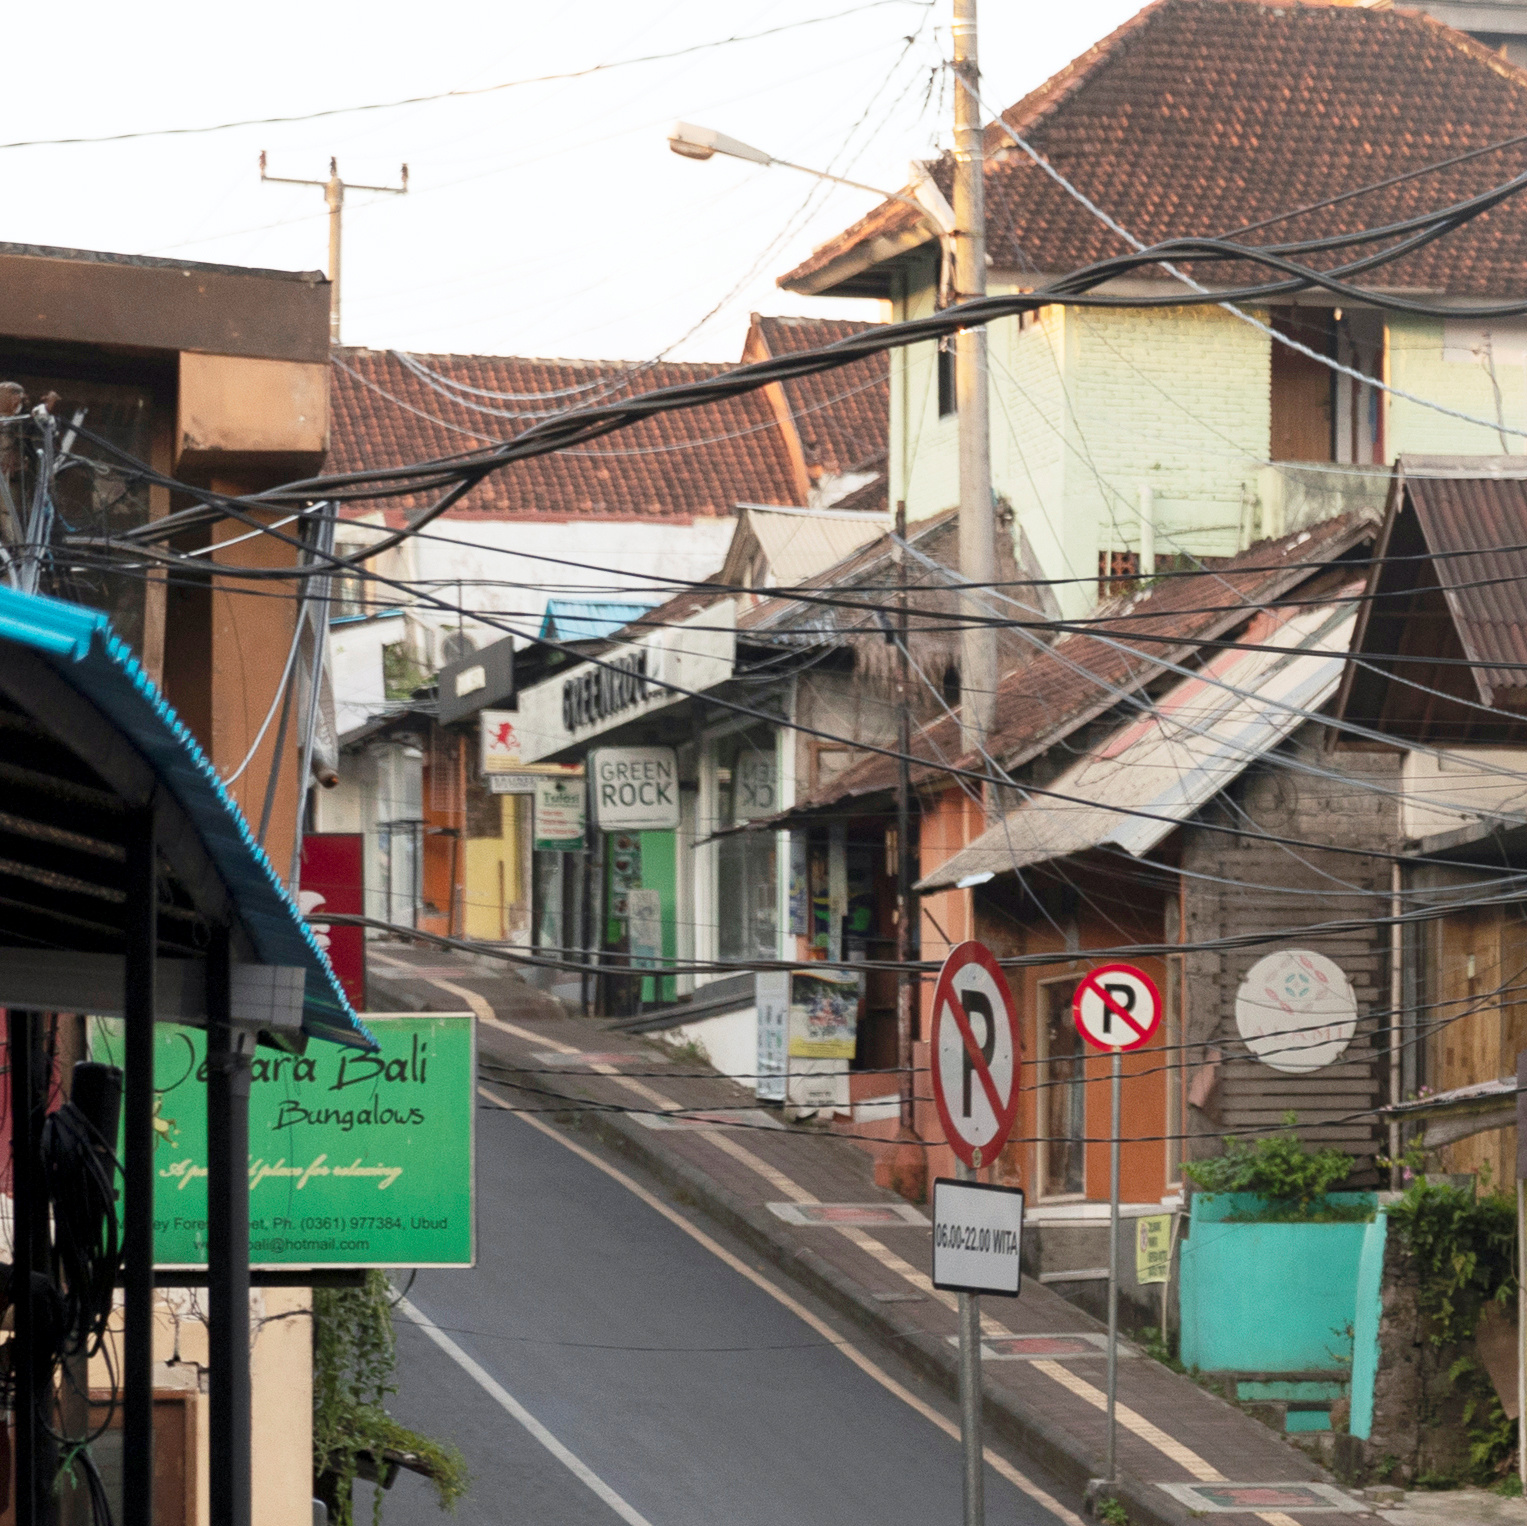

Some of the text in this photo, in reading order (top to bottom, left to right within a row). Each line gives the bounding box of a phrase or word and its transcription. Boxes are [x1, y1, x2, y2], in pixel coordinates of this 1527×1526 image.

[601, 760, 672, 782] GREEN
[602, 782, 673, 808] ROCK
[328, 1032, 428, 1092] Bali
[272, 1093, 426, 1132] Bungalows
[301, 1216, 346, 1233] (0361)
[410, 1217, 448, 1230] Ubud
[936, 1223, 1018, 1256] 06.00-22.00 WITA
